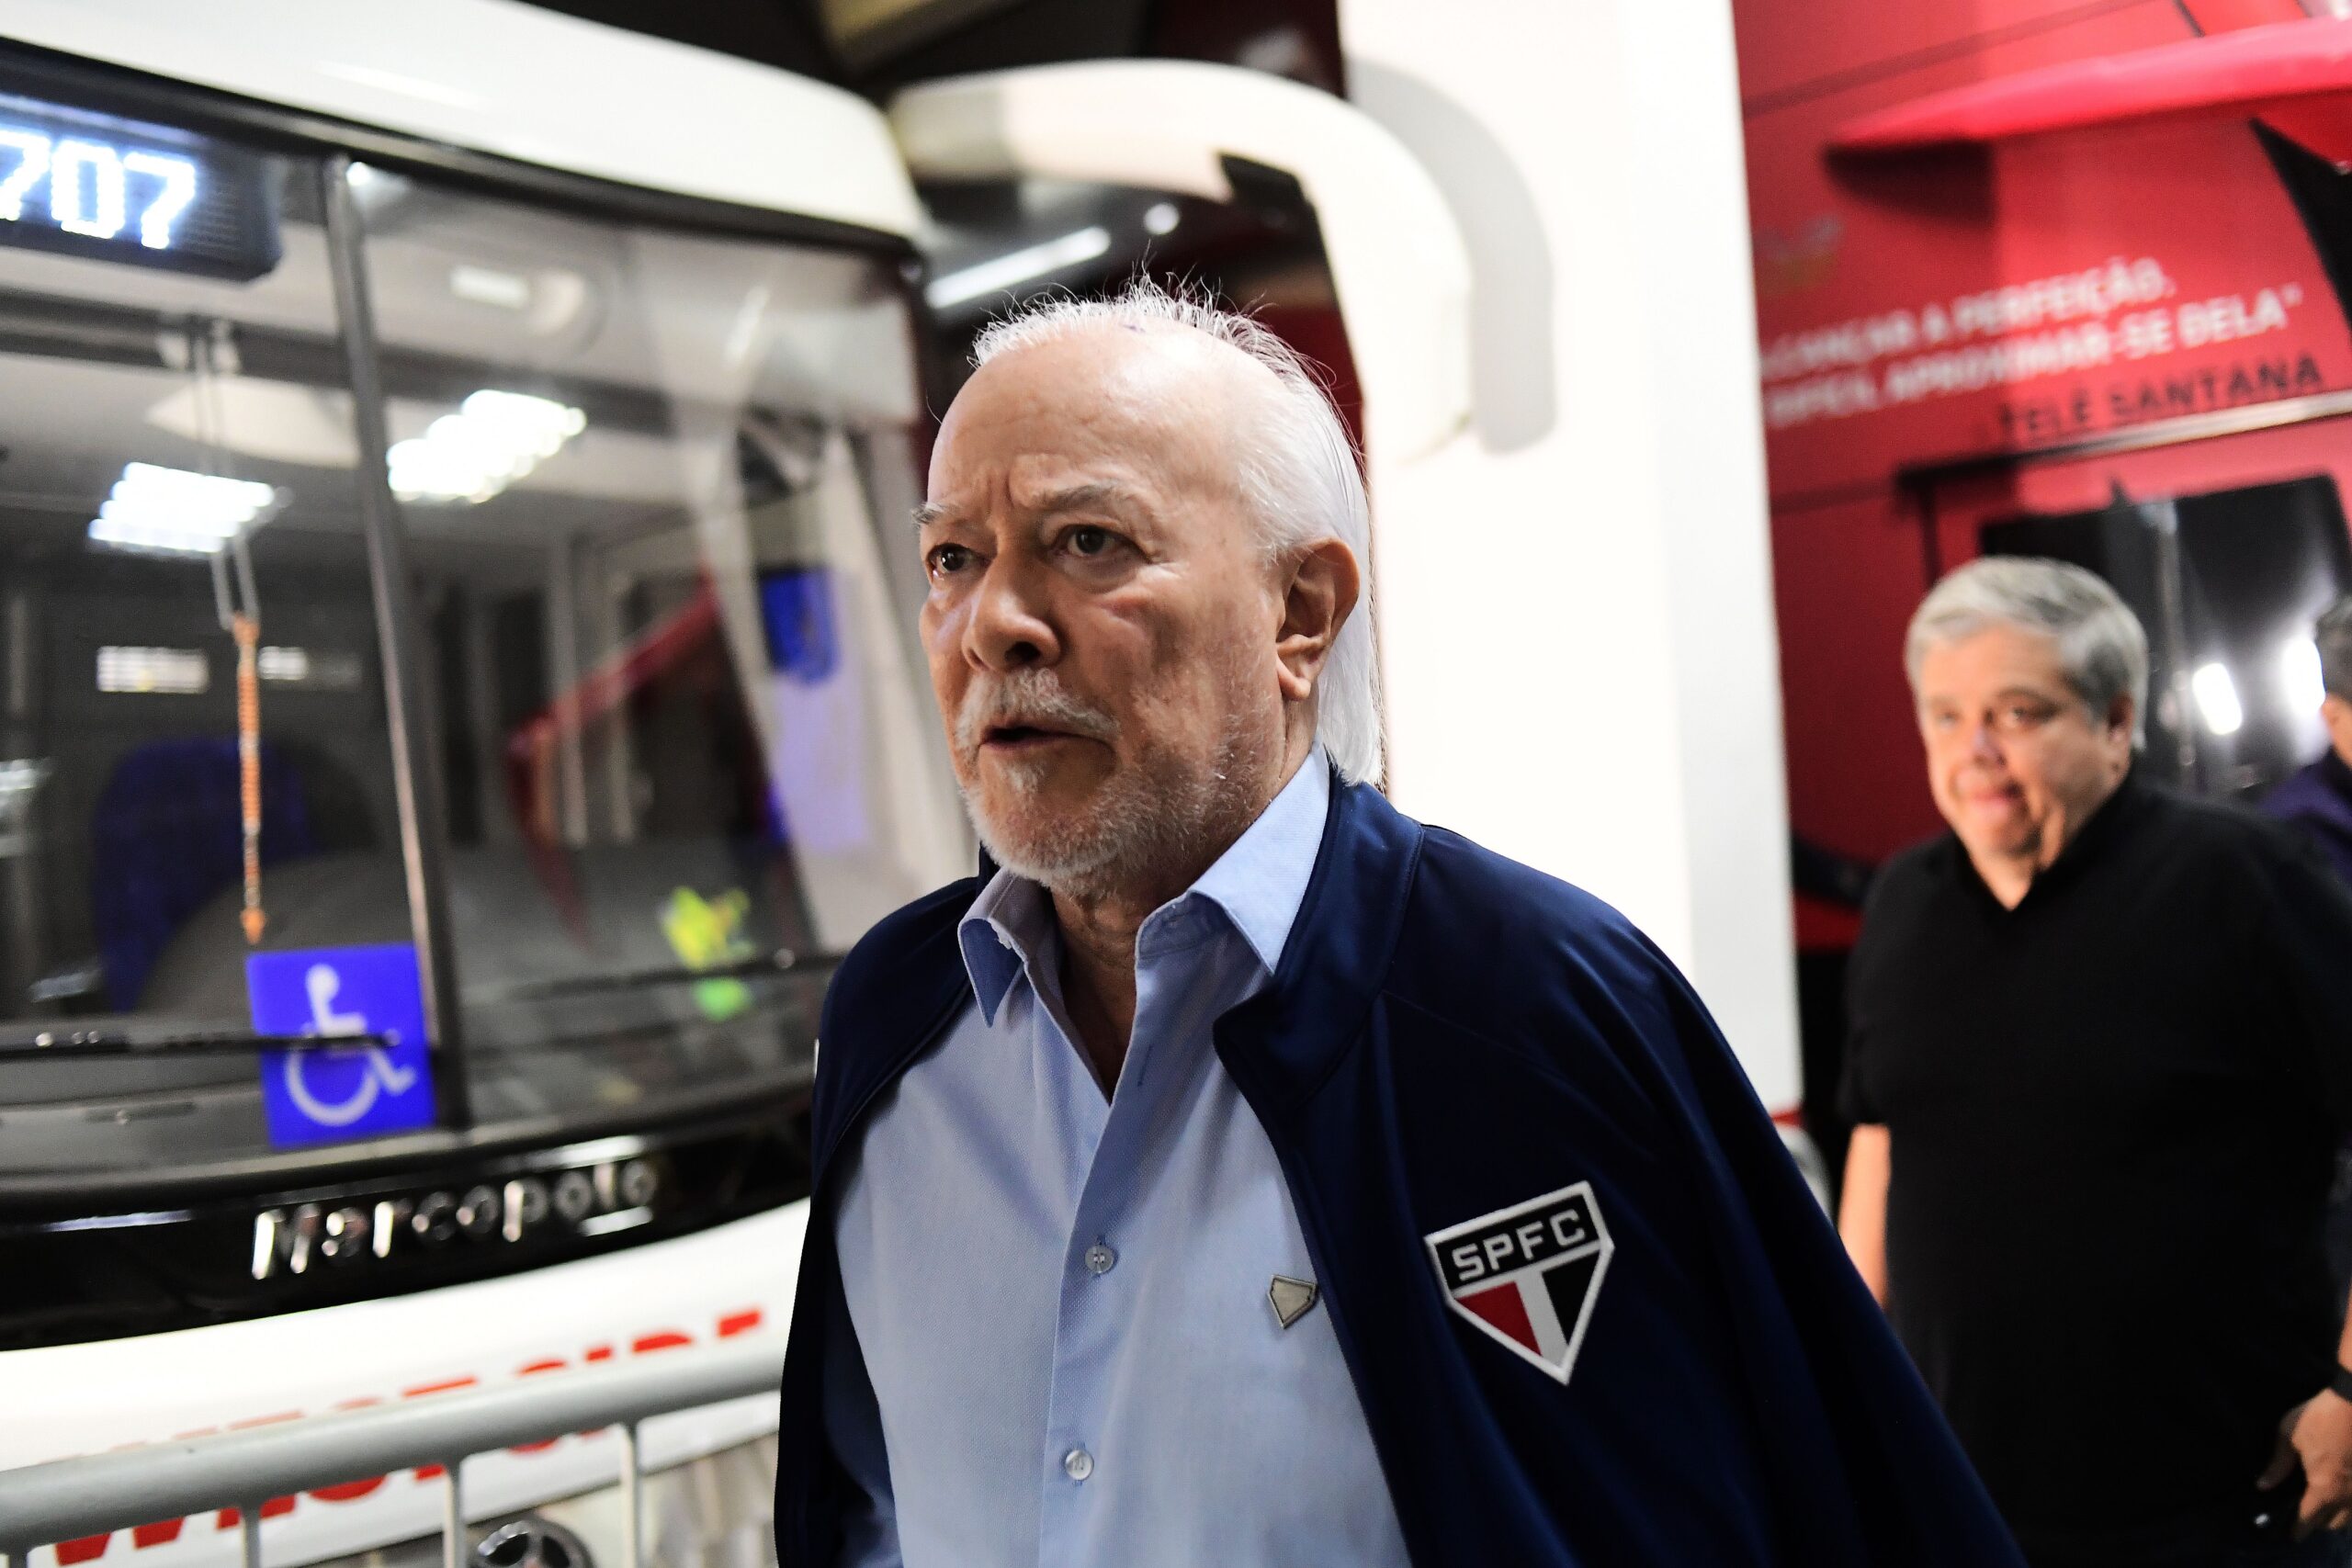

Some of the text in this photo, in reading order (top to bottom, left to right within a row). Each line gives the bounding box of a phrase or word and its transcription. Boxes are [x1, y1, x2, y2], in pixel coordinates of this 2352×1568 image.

[2109, 348, 2324, 417] SANTANA
[252, 1159, 659, 1280] Marcopolo
[1451, 1208, 1586, 1282] SPFC
